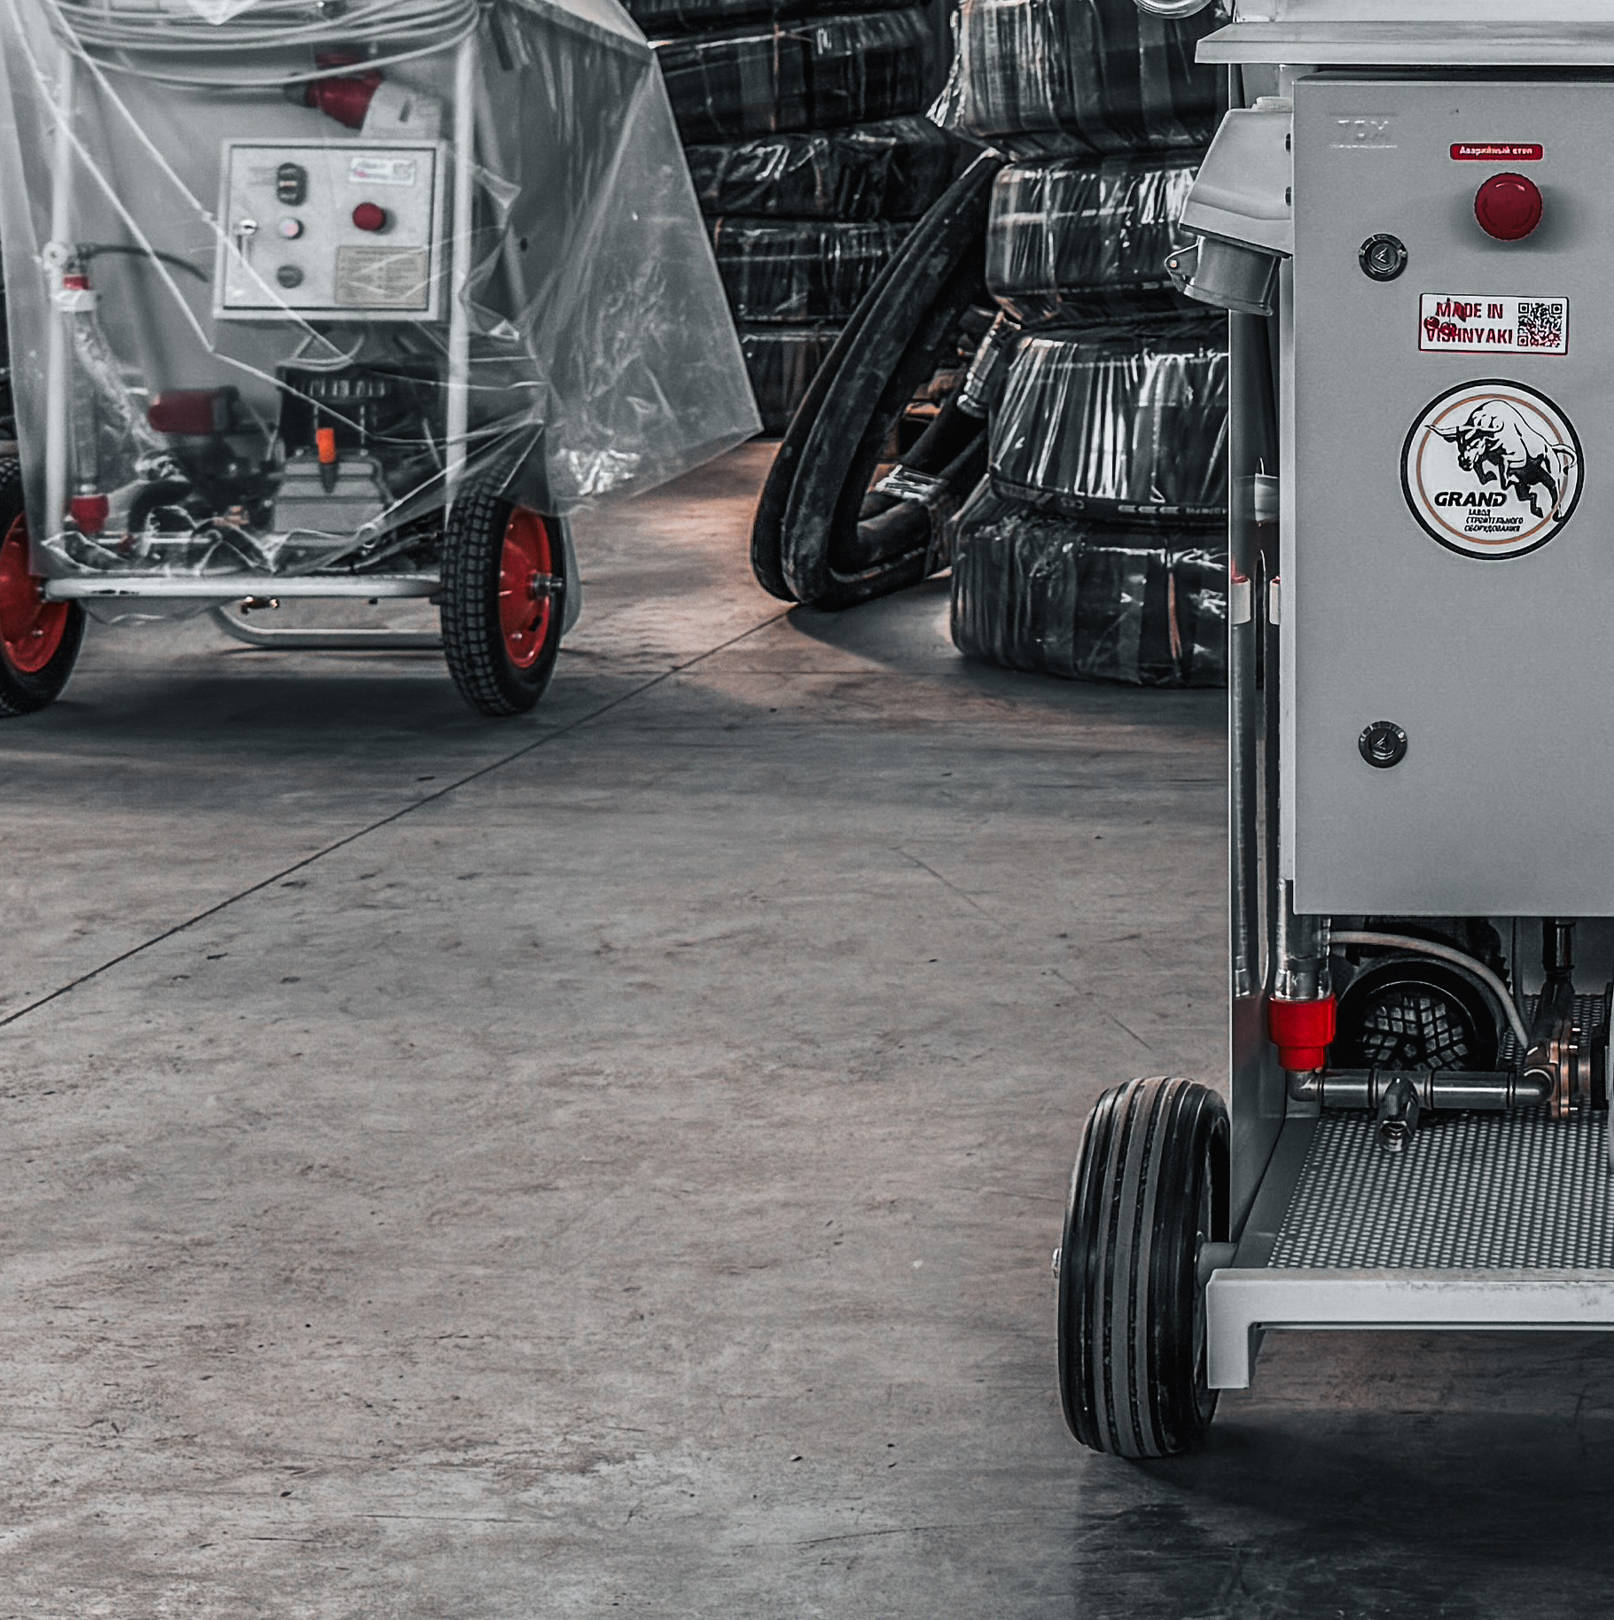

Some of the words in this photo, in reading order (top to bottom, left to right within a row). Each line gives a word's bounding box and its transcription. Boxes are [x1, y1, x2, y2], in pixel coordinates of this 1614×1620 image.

[1436, 301, 1482, 319] MADE
[1487, 303, 1504, 319] IN
[1426, 328, 1513, 345] VISHNYAKI
[1434, 492, 1508, 507] GRAND
